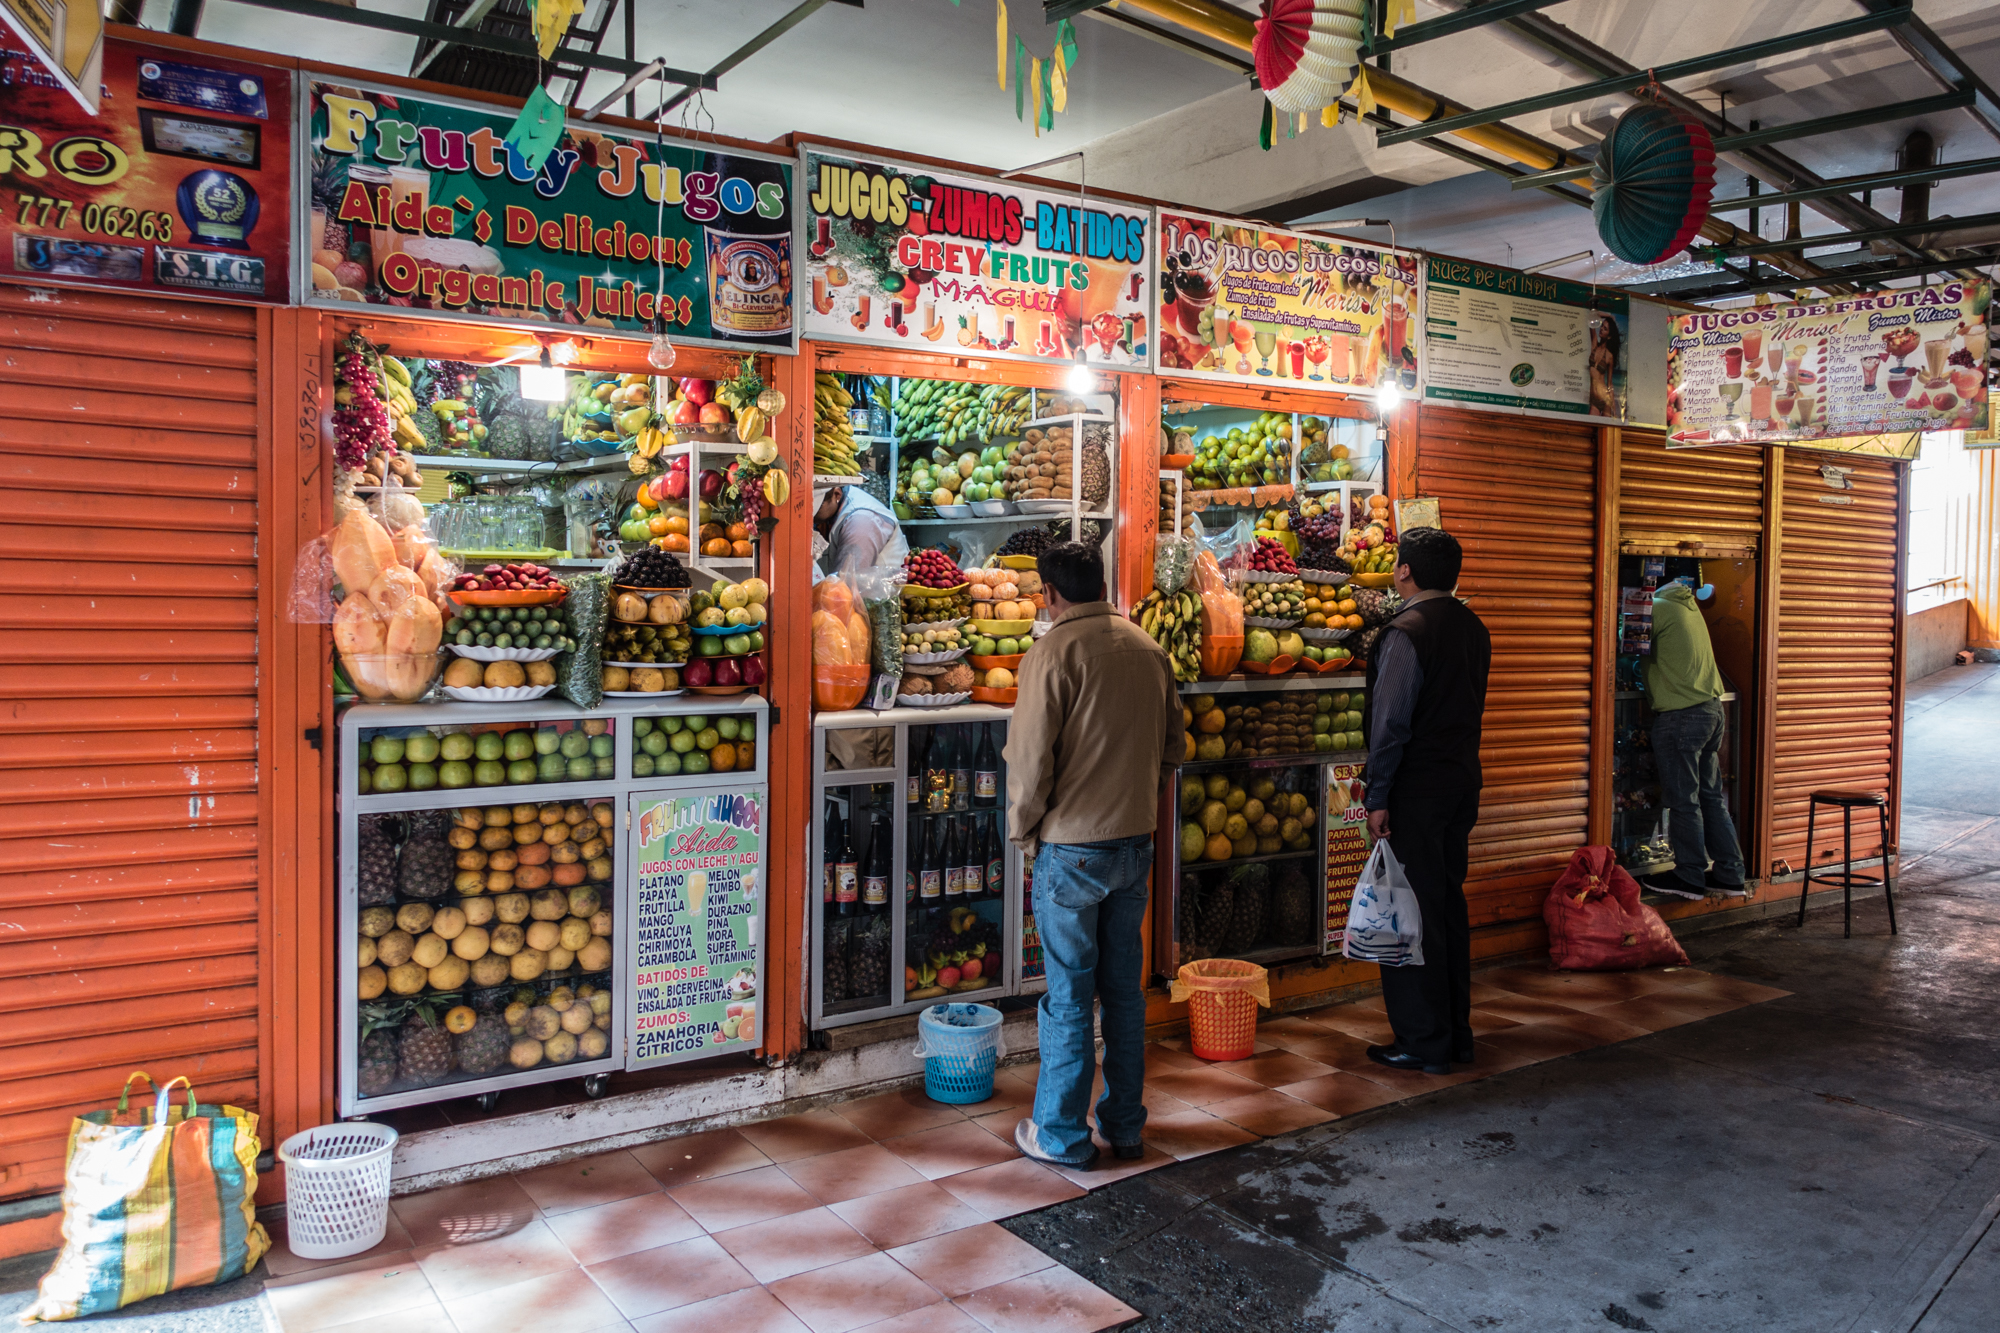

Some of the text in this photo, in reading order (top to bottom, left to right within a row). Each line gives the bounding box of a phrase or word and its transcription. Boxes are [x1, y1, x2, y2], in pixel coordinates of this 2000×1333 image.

[322, 93, 784, 221] Frutty Jugos
[213, 187, 230, 199] 52
[18, 194, 173, 243] 777 06263
[811, 163, 1145, 264] JUGOS ZUMOS BATIDOS
[506, 204, 692, 268] Delicious
[1167, 223, 1416, 285] LOS RICOS JUGOS DE
[172, 252, 261, 284] S.T.G.
[898, 236, 1089, 292] GREY FRUTS
[1222, 273, 1300, 296] Jugos de Fruta con Leche
[1430, 261, 1557, 299] NUEZ DE LA INDIA
[382, 251, 692, 326] Organic Juices
[932, 277, 1061, 312] MAGUI
[1226, 289, 1277, 307] Zumos de Fruta
[1684, 283, 1963, 334] JUGOS DE FRUTAS
[1241, 305, 1274, 323] Ensaladas
[1274, 311, 1283, 323] de
[1283, 312, 1305, 327] Frutas
[1305, 318, 1311, 329] y
[1868, 307, 1960, 331] Zumos Mixtos
[1567, 330, 1582, 340] cuarto
[1670, 331, 1742, 352] Jugos Mixtos
[1829, 333, 1871, 344] De frutas
[1570, 339, 1583, 348] cada
[1829, 342, 1886, 354] De Zanahoria
[1703, 348, 1725, 357] Leche
[1828, 355, 1846, 364] Piña
[1828, 375, 1862, 386] Naranja
[1829, 384, 1862, 394] Toronja
[1828, 392, 1887, 404] Con vegetales
[1827, 423, 1865, 433] Cereales
[1866, 422, 1882, 431] con
[1883, 420, 1913, 433] yogurt
[1923, 417, 1947, 428] Jugo
[1828, 413, 1870, 424] Ensaladas
[1872, 412, 1882, 420] de
[1885, 410, 1910, 419] Fruta
[1335, 766, 1349, 779] SE
[640, 796, 707, 847] FRUTTY
[670, 825, 739, 855] Aida
[1328, 827, 1360, 840] PAPAYA
[1328, 839, 1366, 852] PLATANO
[640, 860, 673, 875] JUGOS
[675, 858, 696, 871] CON
[698, 855, 728, 870] LECHE
[730, 853, 737, 866] Y
[1328, 851, 1371, 865] MARACUYA
[708, 869, 740, 883] MELON
[1327, 864, 1364, 877] FRUTILLA
[639, 874, 684, 891] PLATANO
[708, 880, 741, 894] TUMBO
[1328, 876, 1358, 890] MANGO
[639, 888, 677, 903] PAPAYA
[708, 893, 729, 906] KIWI
[639, 900, 685, 916] FRUTILLA
[708, 903, 752, 918] DURAZNO
[1328, 902, 1347, 914] PIÑA
[639, 914, 674, 929] MANGO
[638, 925, 692, 942] MARACUYA
[707, 929, 734, 942] MORA
[1327, 931, 1344, 940] SUPER
[638, 938, 692, 955] CHIRIMOYA
[707, 940, 737, 955] SUPER
[638, 950, 697, 968] CARAMBOLA
[637, 965, 708, 986] BATIDOS DE:
[637, 977, 724, 1001] VINO BICERVECINA
[637, 988, 733, 1014] ENSALADA DE FRUTAS
[637, 1013, 691, 1030] ZUMOS:
[636, 1021, 720, 1046] ZANAHORIA
[636, 1036, 704, 1058] CITRICOS
